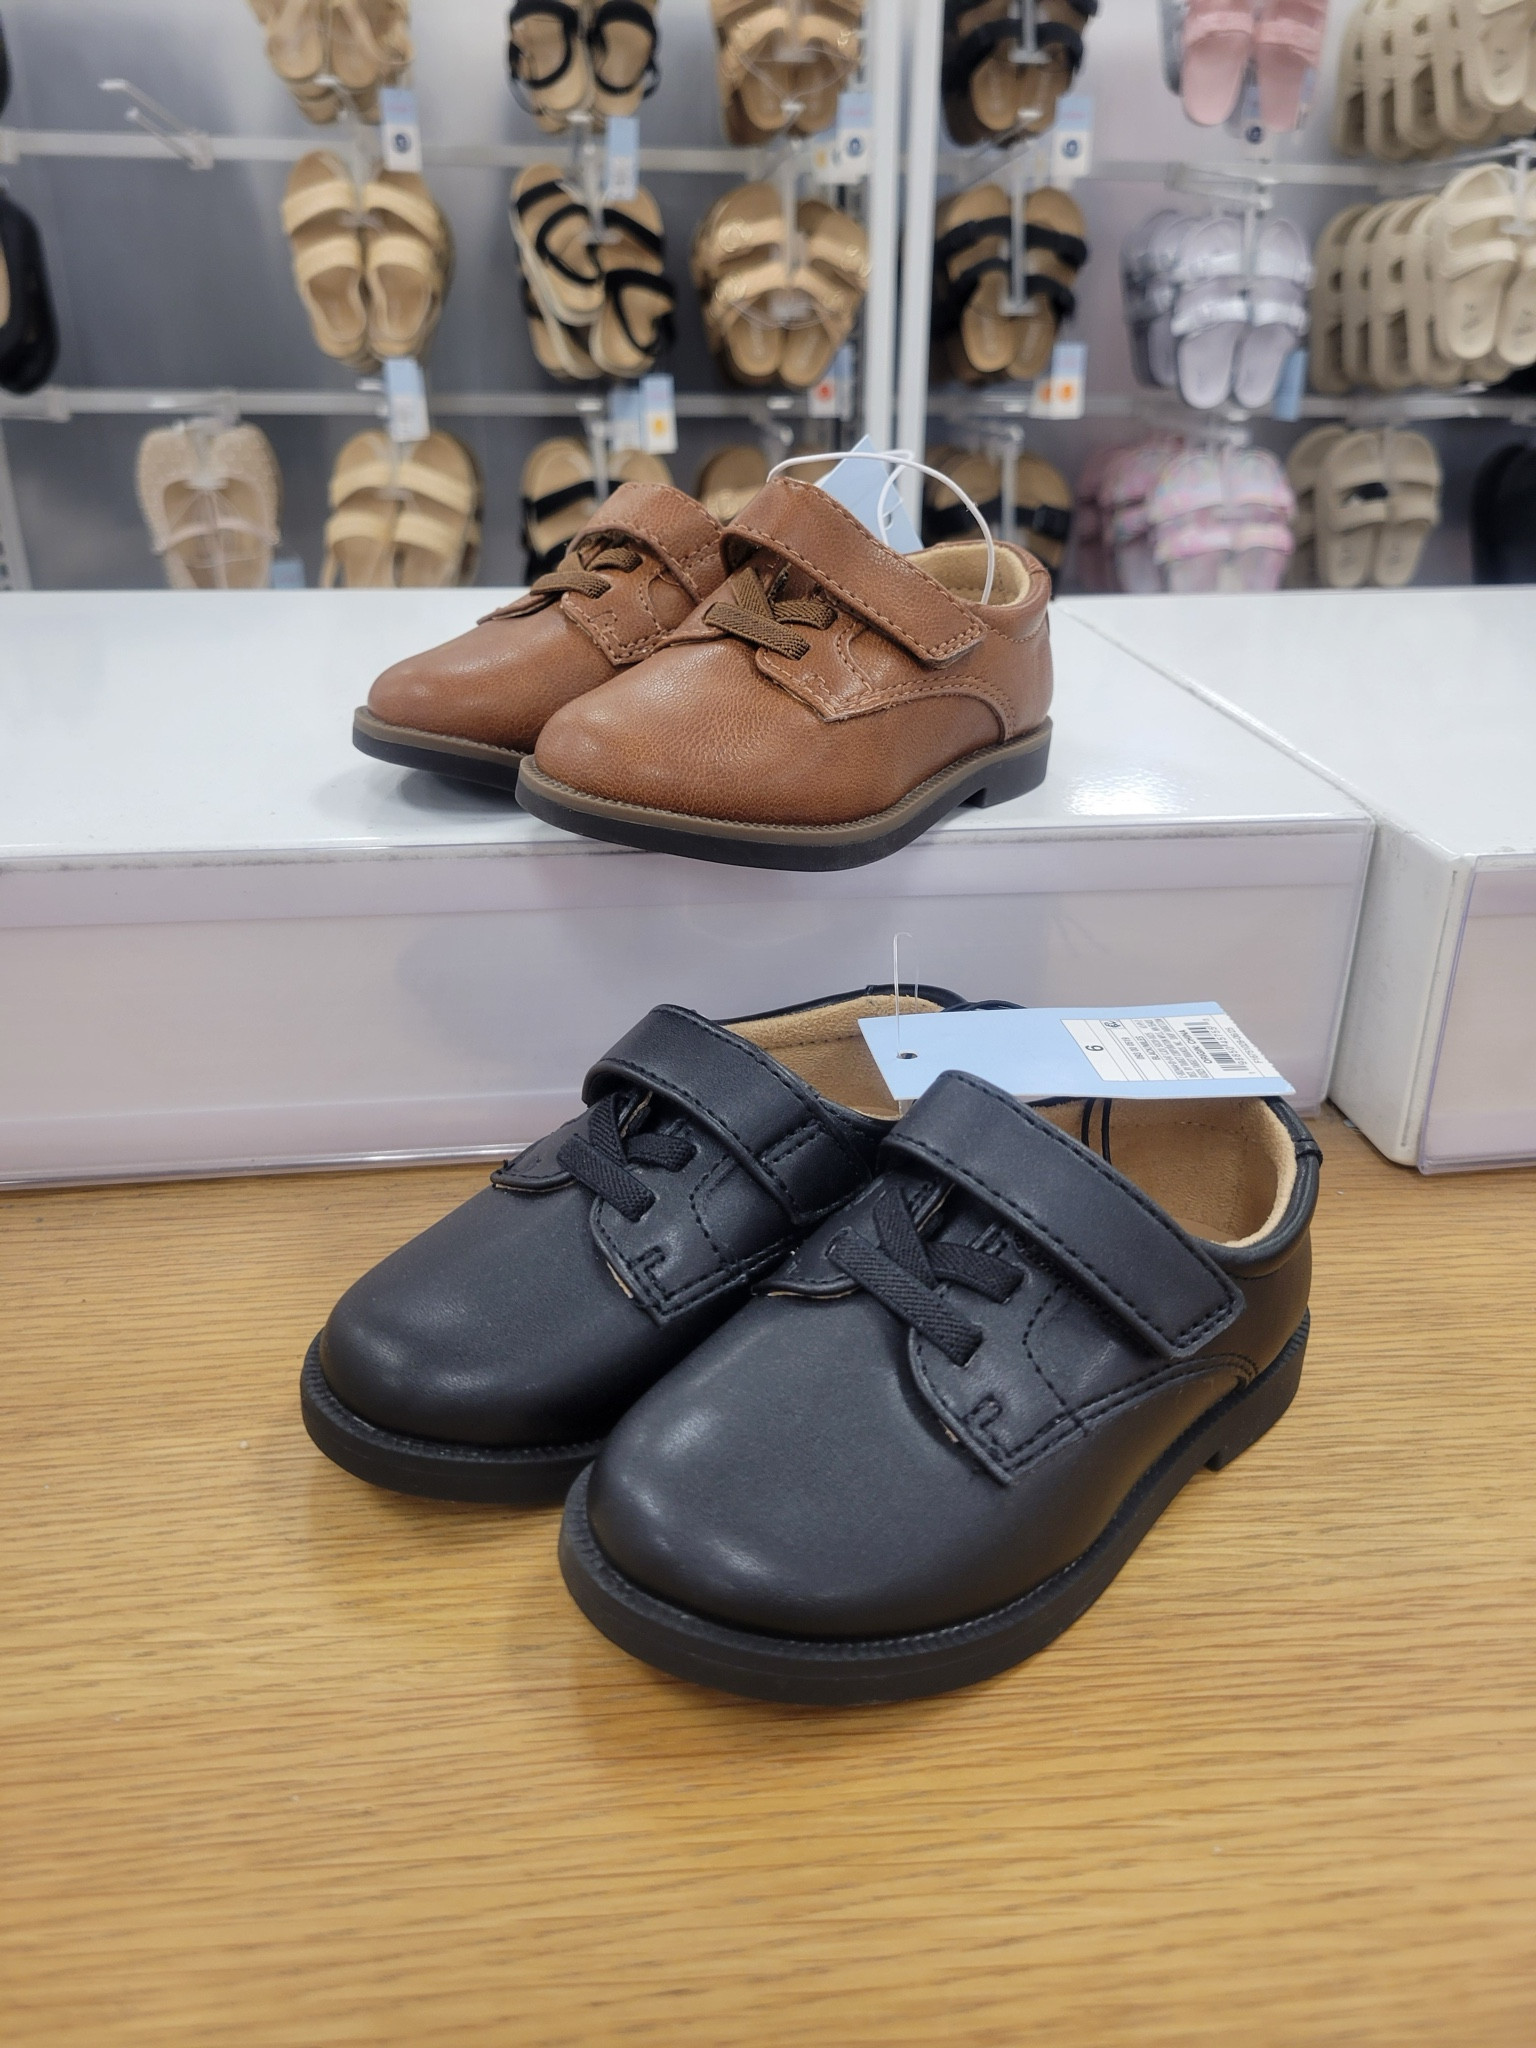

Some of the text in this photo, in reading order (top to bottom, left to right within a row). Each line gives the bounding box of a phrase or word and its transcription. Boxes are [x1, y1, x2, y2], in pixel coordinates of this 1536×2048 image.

[1084, 1044, 1104, 1052] 6
[1178, 1029, 1213, 1064] ORIGIN: CHINA
